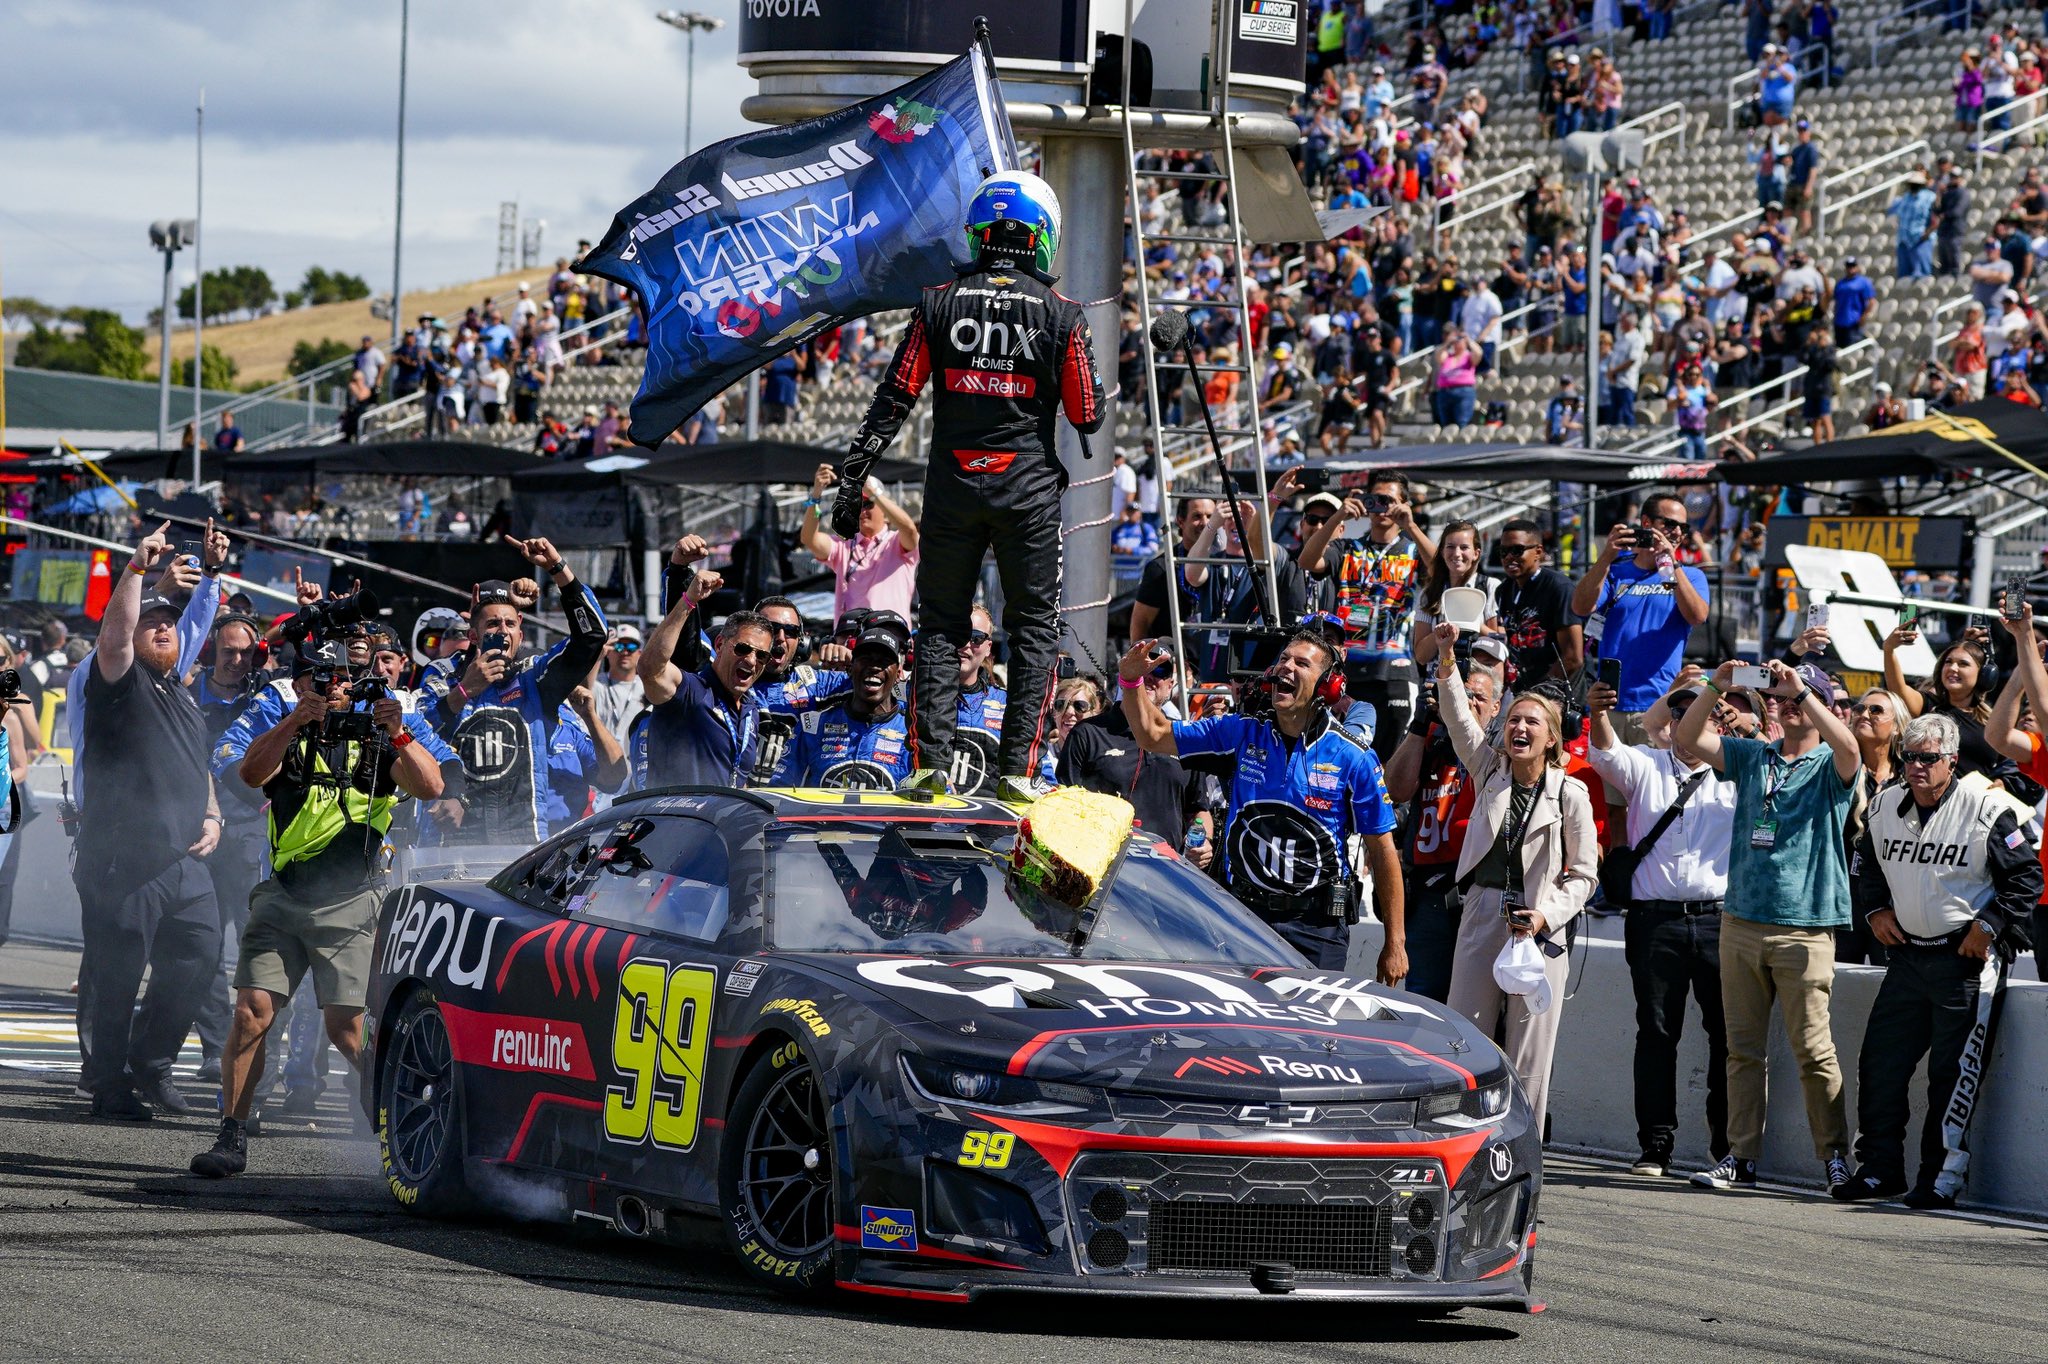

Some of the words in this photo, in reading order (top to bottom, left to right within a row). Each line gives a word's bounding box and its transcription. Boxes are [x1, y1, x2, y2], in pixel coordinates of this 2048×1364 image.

[747, 0, 820, 19] TOYOTA
[1262, 1, 1292, 18] NASCAR
[1250, 19, 1268, 31] CUP
[1268, 20, 1292, 34] SERIES
[981, 244, 1036, 256] TRACKHOUSE
[971, 356, 1014, 371] HOMES
[987, 377, 1027, 395] Renu
[1882, 838, 1969, 867] OFFICIAL
[380, 884, 505, 991] Renu
[760, 998, 832, 1038] GOODYEAR
[1077, 997, 1338, 1027] HOMES
[492, 1023, 572, 1072] renu.inc
[603, 956, 718, 1154] 99
[1258, 1055, 1363, 1085] Renu
[1944, 1023, 1986, 1130] OFFICIAL
[957, 1130, 1017, 1170] 99
[1388, 1169, 1436, 1183] ZL1
[865, 1222, 913, 1237] SUNOCO
[741, 1239, 802, 1277] EAGLE
